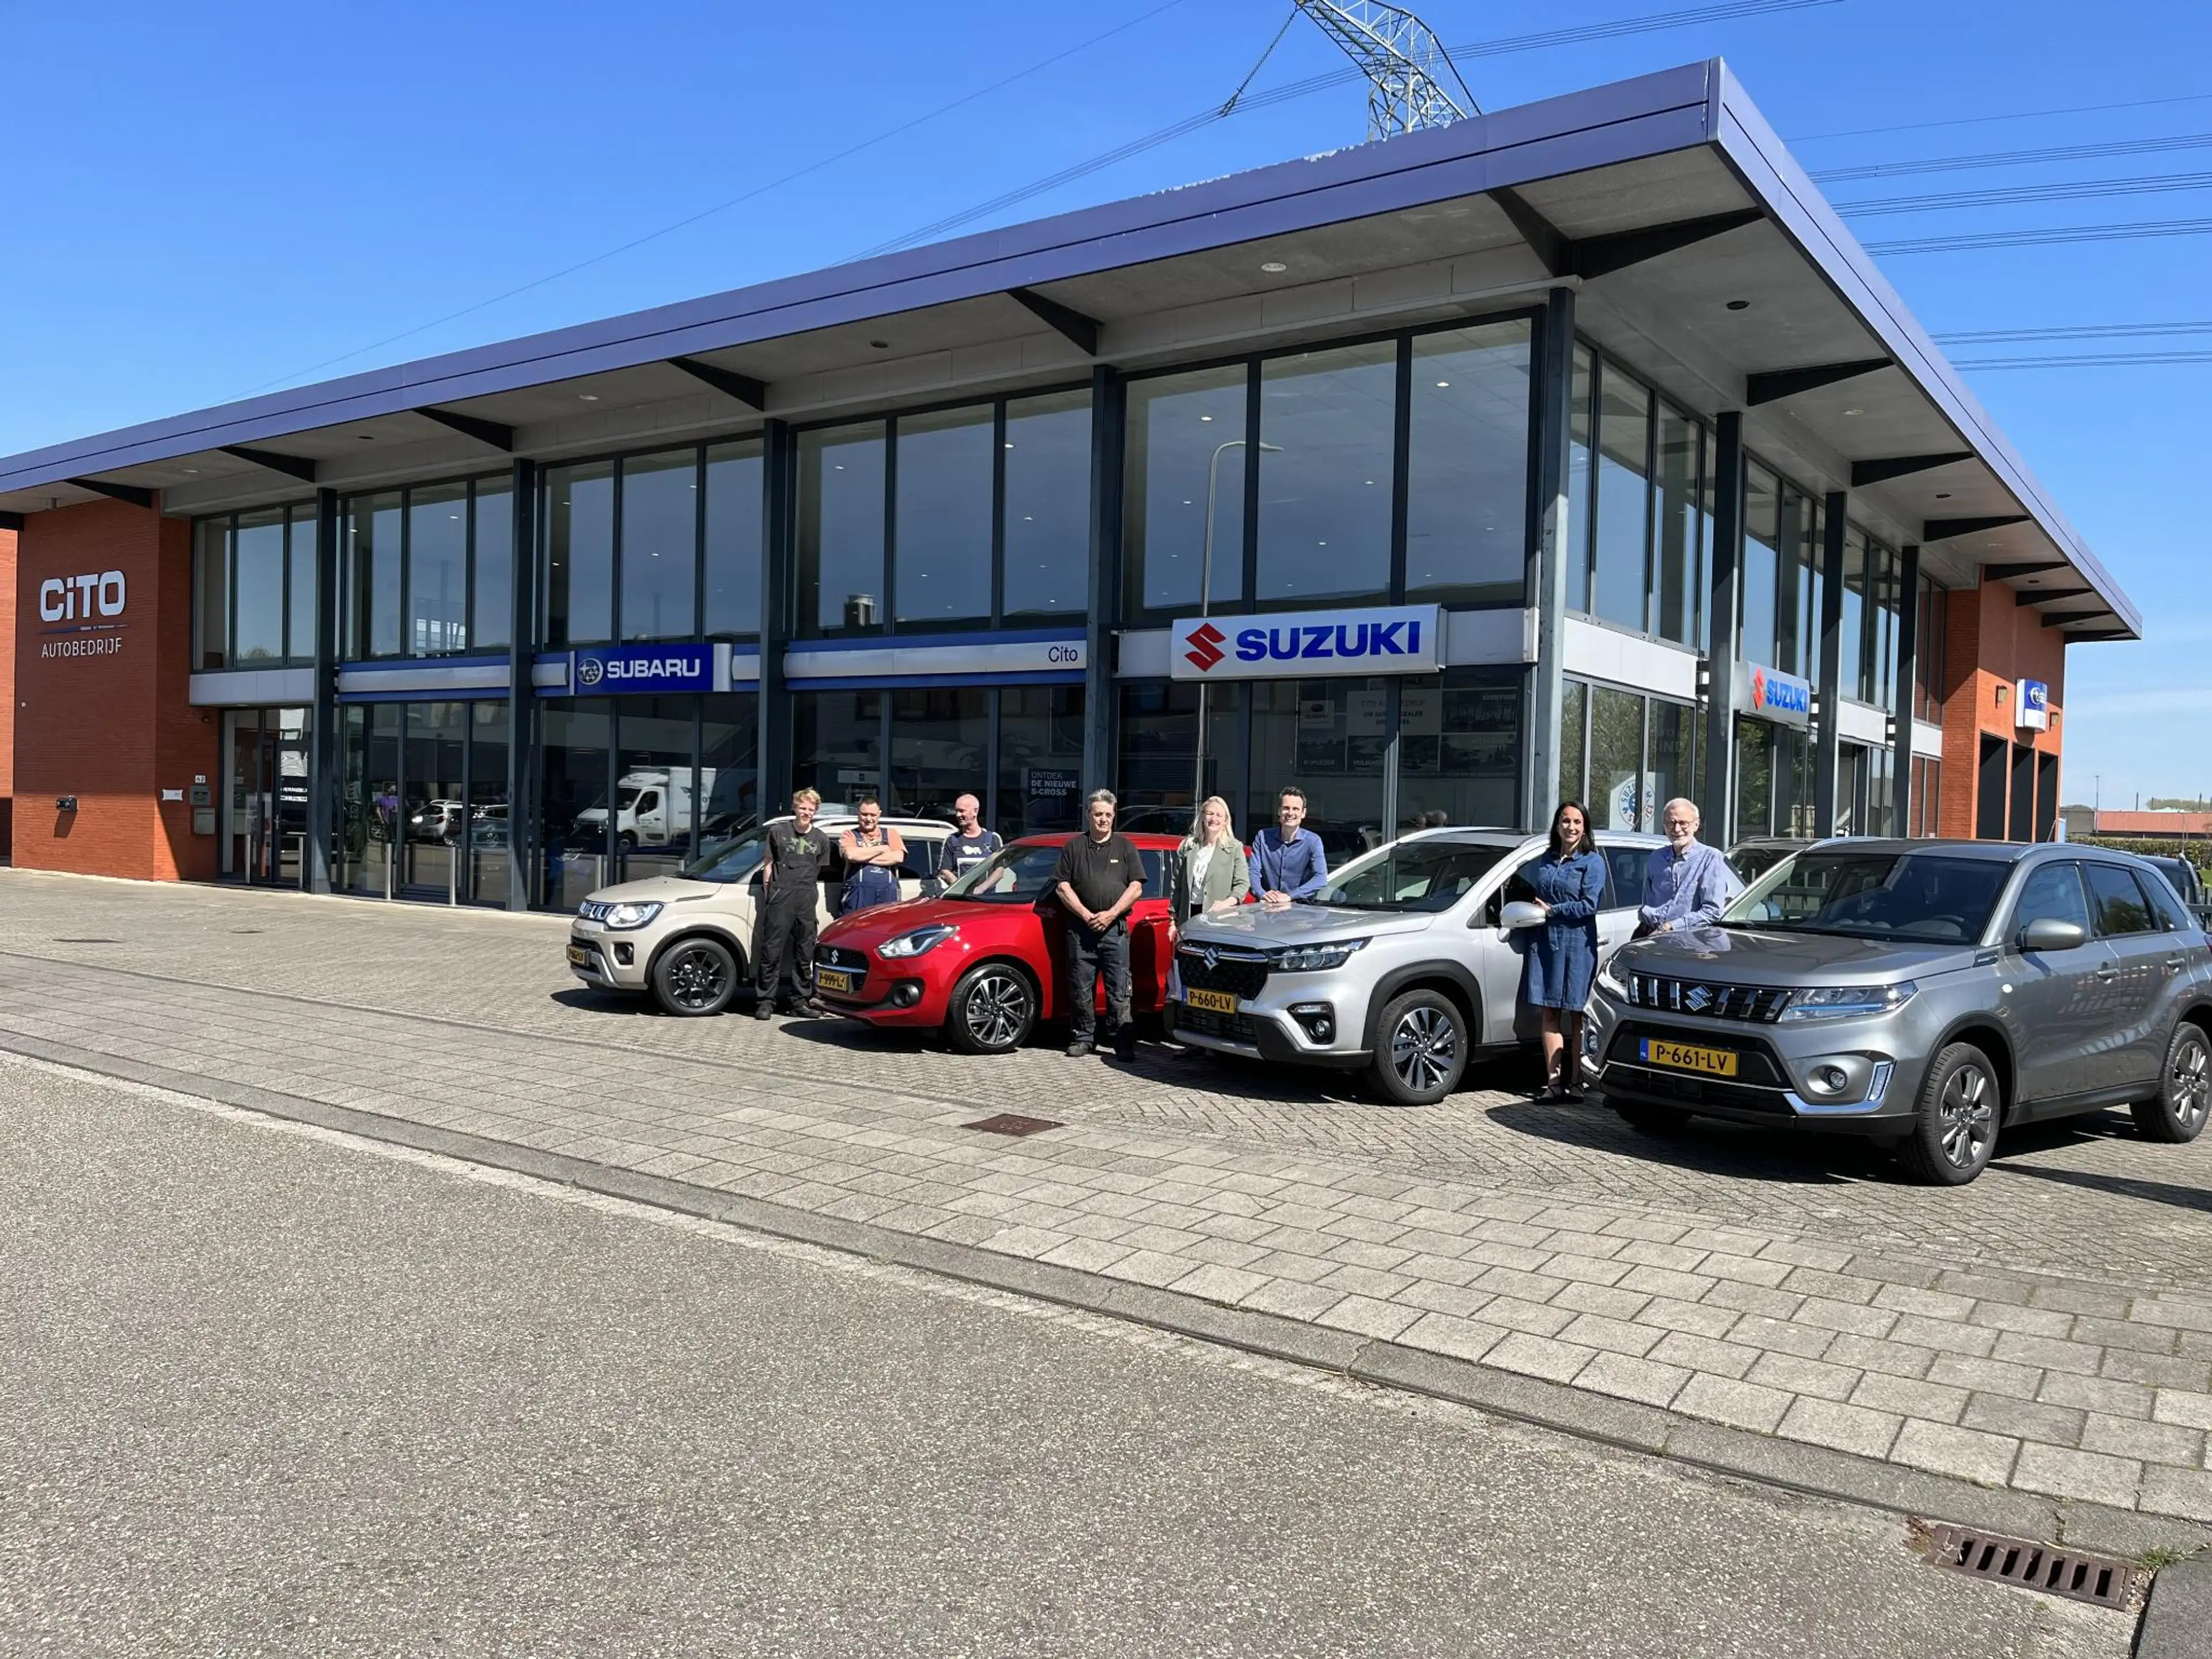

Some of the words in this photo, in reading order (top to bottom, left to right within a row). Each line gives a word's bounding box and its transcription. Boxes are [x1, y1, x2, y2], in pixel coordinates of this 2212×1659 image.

[41, 638, 122, 658] AUTOBEDRIJF
[1236, 621, 1420, 661] SUZUKI
[1048, 646, 1078, 662] Cito
[607, 659, 700, 678] SUBARU
[1767, 679, 1807, 713] SUZUKI
[1190, 990, 1232, 1010] P-660-LV
[1657, 1044, 1728, 1070] P-661-LV
